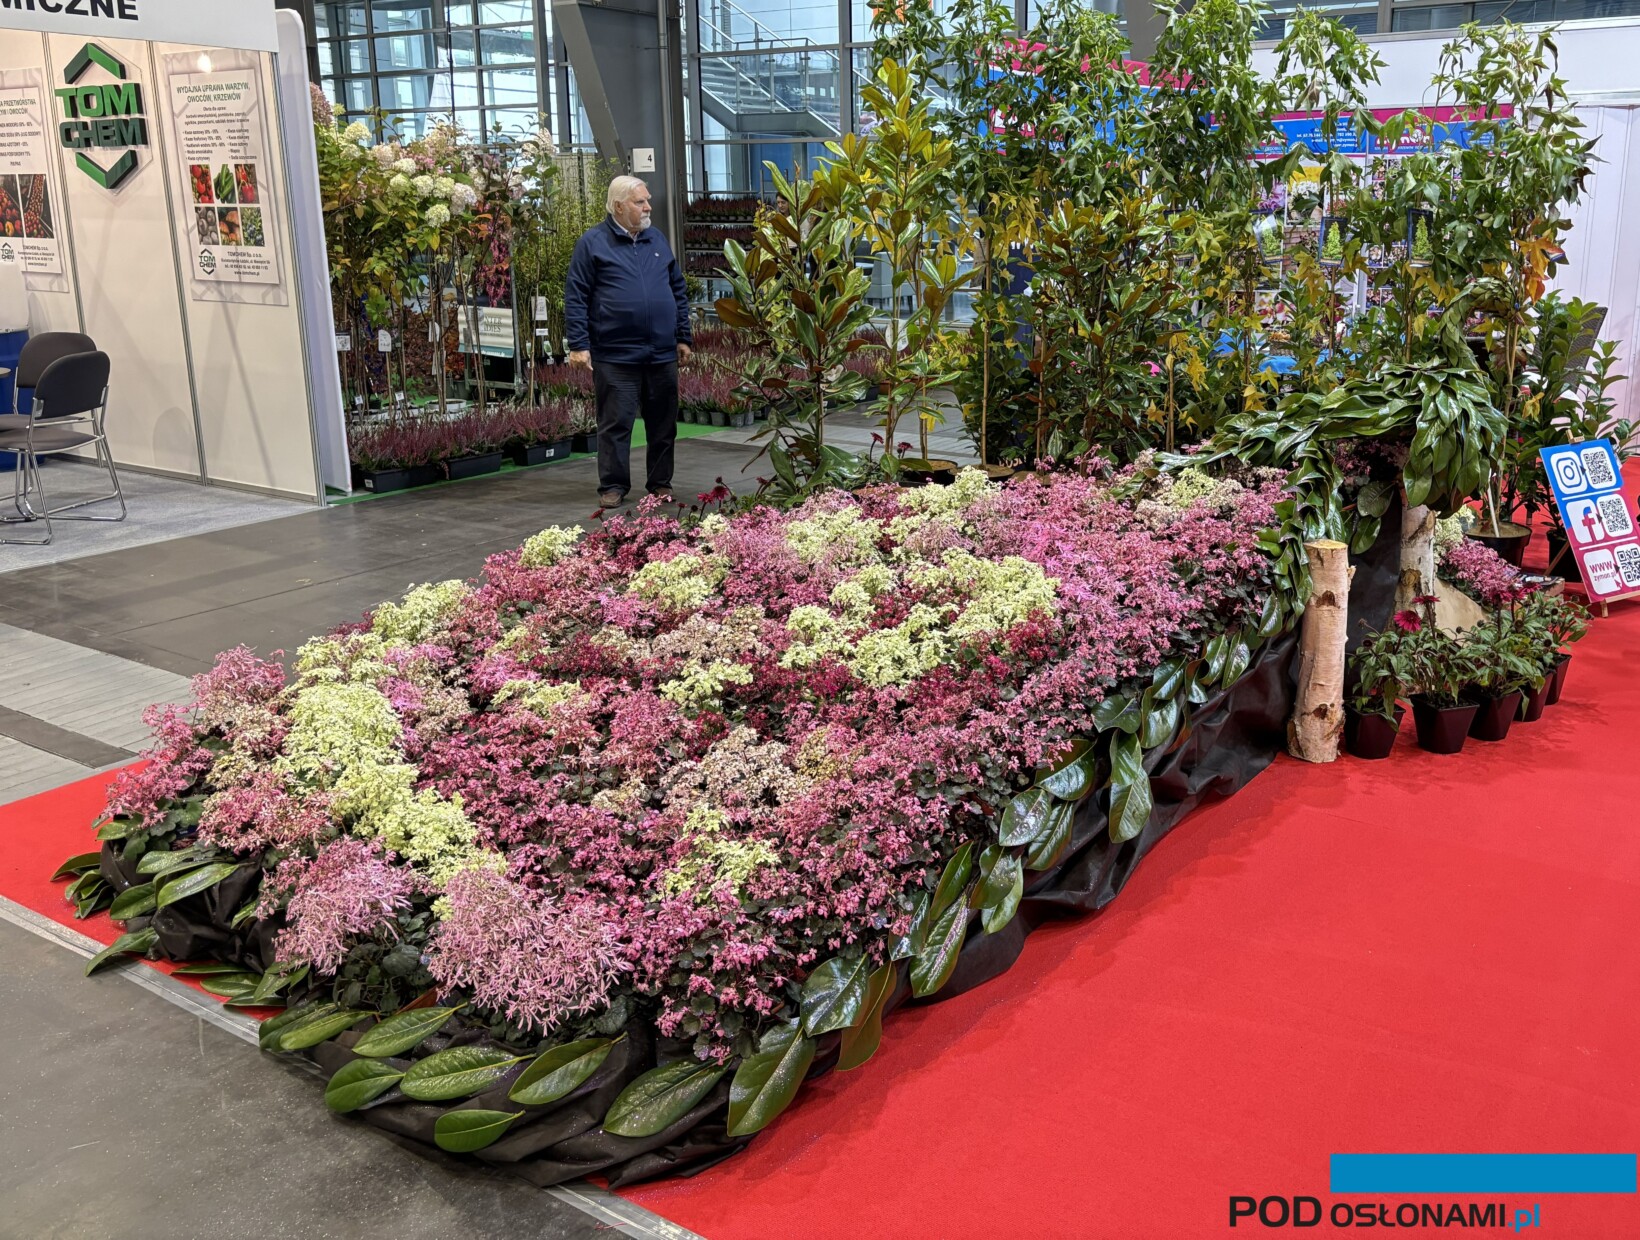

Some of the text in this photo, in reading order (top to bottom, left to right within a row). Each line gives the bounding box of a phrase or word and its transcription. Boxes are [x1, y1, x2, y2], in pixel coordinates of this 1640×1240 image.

[176, 82, 250, 94] WYDAJNA UPRAWA WARZYW,
[54, 83, 143, 119] TOM
[214, 92, 241, 101] KRZEWÓW
[59, 118, 148, 148] CHEM
[647, 154, 653, 162] 4
[1594, 571, 1617, 582] zymon.pl
